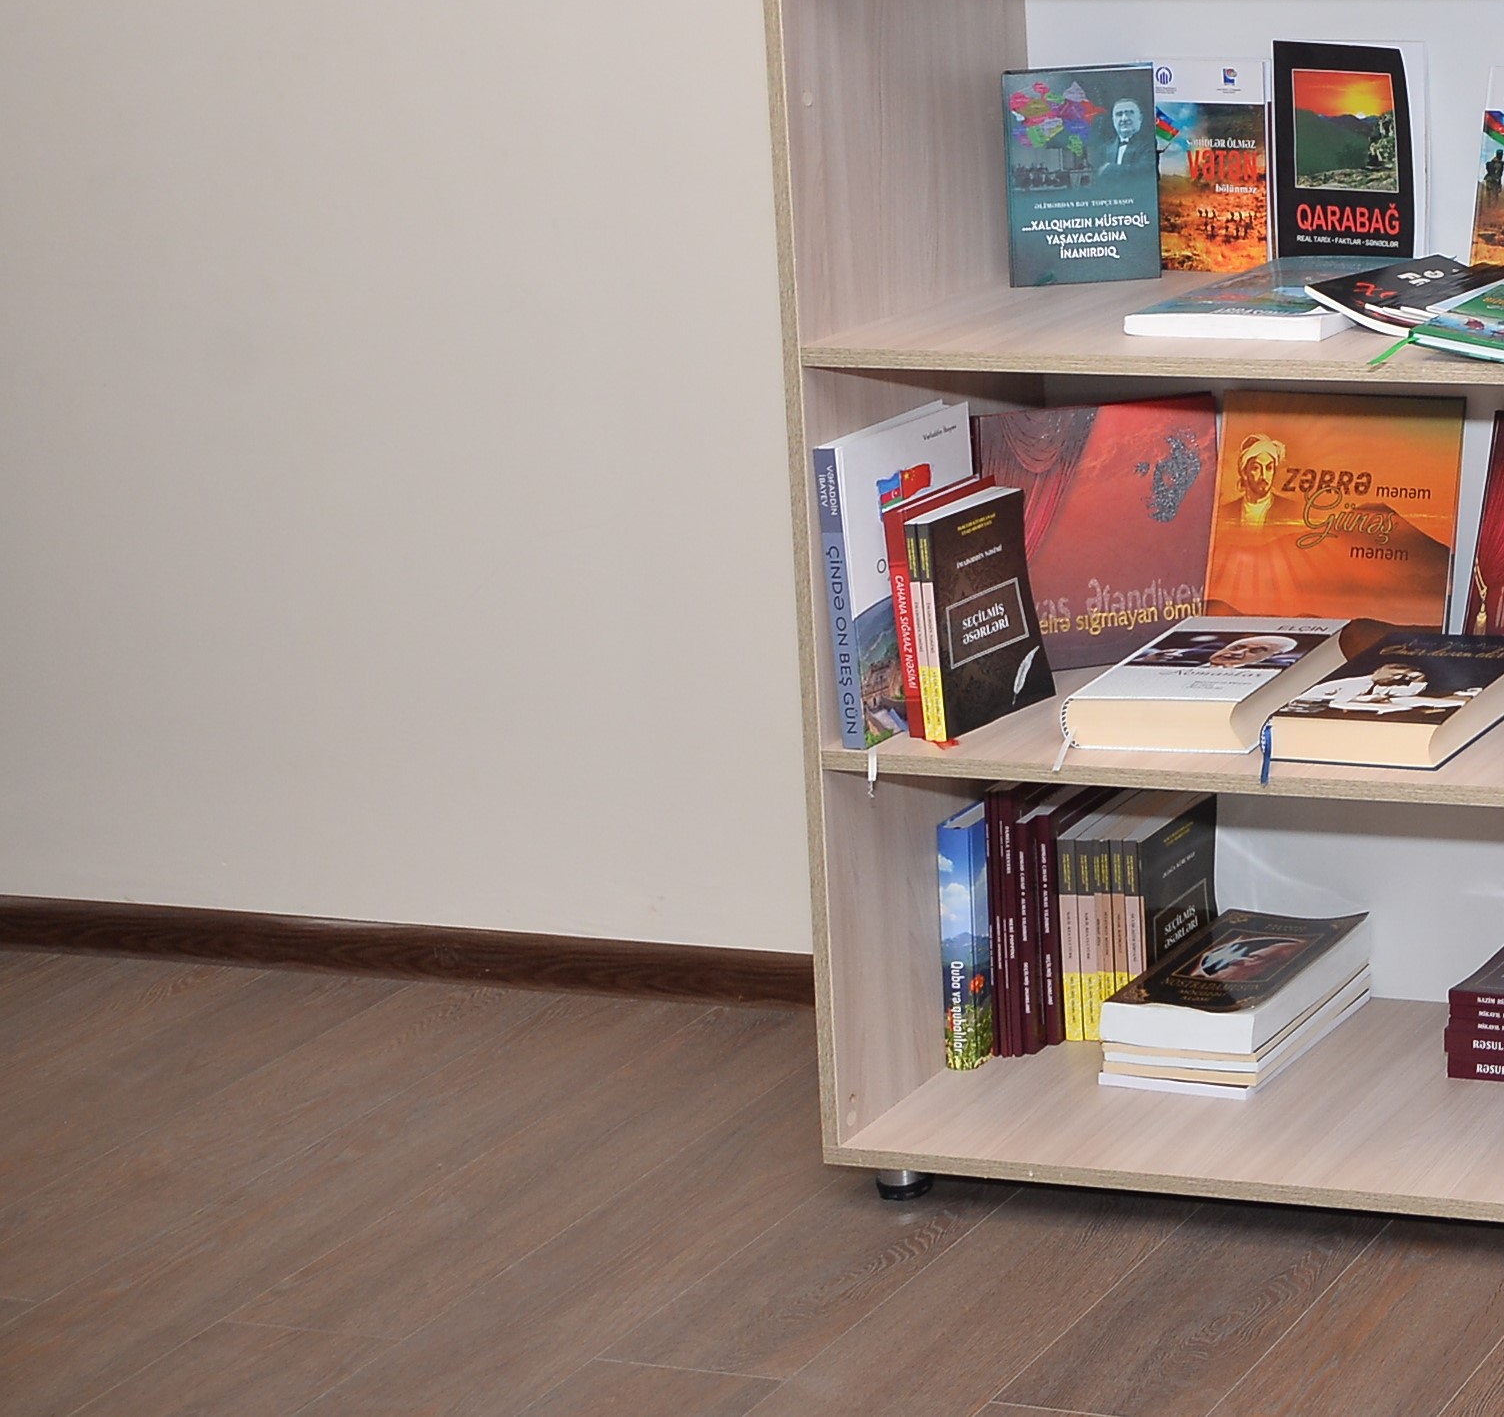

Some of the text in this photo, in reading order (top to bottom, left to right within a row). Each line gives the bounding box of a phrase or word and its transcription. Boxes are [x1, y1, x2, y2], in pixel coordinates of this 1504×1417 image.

[1187, 150, 1257, 182] VƏTƏN
[1215, 184, 1258, 194] bölünməz
[1095, 214, 1150, 227] MÜSTƏQİL
[1296, 202, 1400, 235] QARABAĞ
[1046, 231, 1127, 247] YAŞAYACAĞINA
[1060, 246, 1120, 259] İNANIRDIQ
[1335, 237, 1361, 246] FAKTLAR
[818, 474, 829, 507] İBAYEV
[1281, 467, 1432, 501] ZƏRRƏ mənəm
[1297, 486, 1399, 549] Günəş
[1350, 544, 1409, 561] mənəm
[962, 602, 1006, 630] SEÇİLMİŞ
[1076, 605, 1159, 635] sığmayan
[826, 545, 856, 735] ÇİNDƏ ON BEŞ GÜN
[962, 617, 1010, 645] ƏSƏRLƏRİ
[1164, 905, 1197, 937] SEÇİLMİŞ
[1164, 916, 1199, 951] ƏSƏRLƏRİ
[1473, 1040, 1504, 1051] RƏSUL
